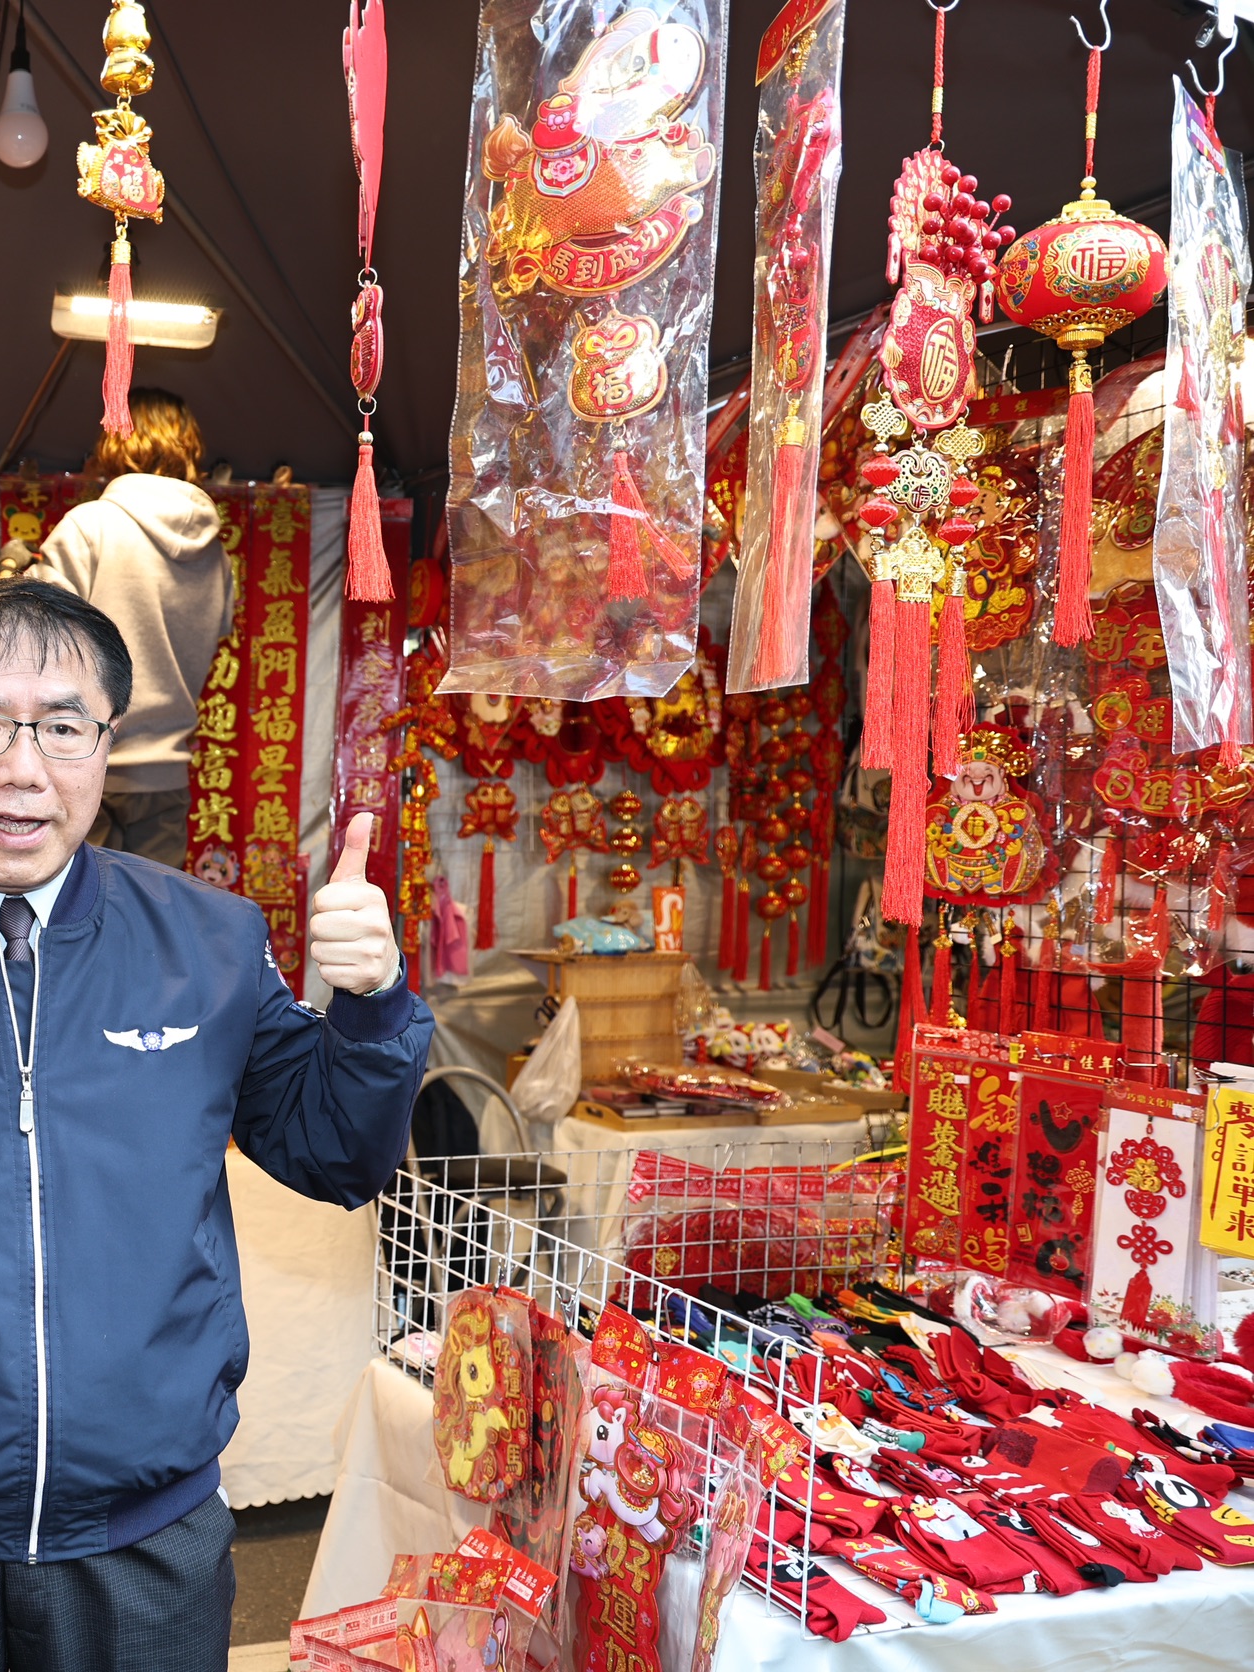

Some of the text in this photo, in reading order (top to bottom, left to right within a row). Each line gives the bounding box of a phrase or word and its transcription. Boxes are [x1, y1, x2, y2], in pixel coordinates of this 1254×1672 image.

[547, 219, 669, 286] 馬到成功
[1072, 239, 1127, 282] 福
[927, 322, 958, 401] 福
[245, 498, 305, 843] 喜氣盈門福星照
[1134, 705, 1166, 737] 祥
[493, 1337, 527, 1477] 好運加馬
